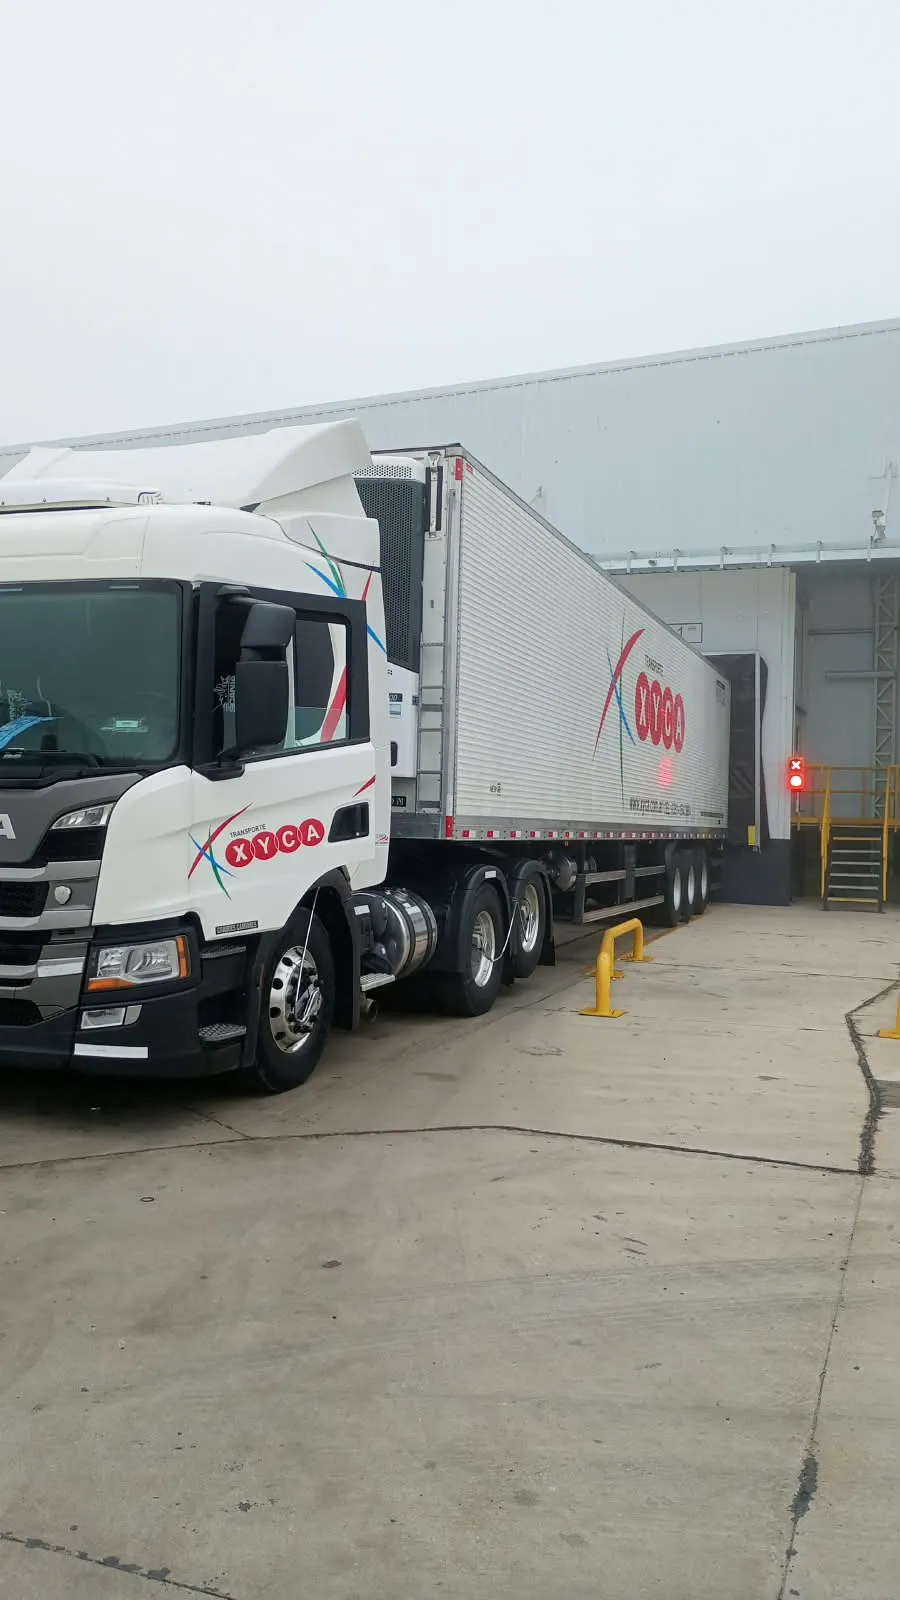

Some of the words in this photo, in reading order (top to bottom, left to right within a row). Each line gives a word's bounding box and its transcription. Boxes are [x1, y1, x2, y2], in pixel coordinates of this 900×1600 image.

[638, 684, 684, 741] XYCA
[229, 823, 267, 838] TRANSPORTE
[232, 823, 320, 863] XYCA
